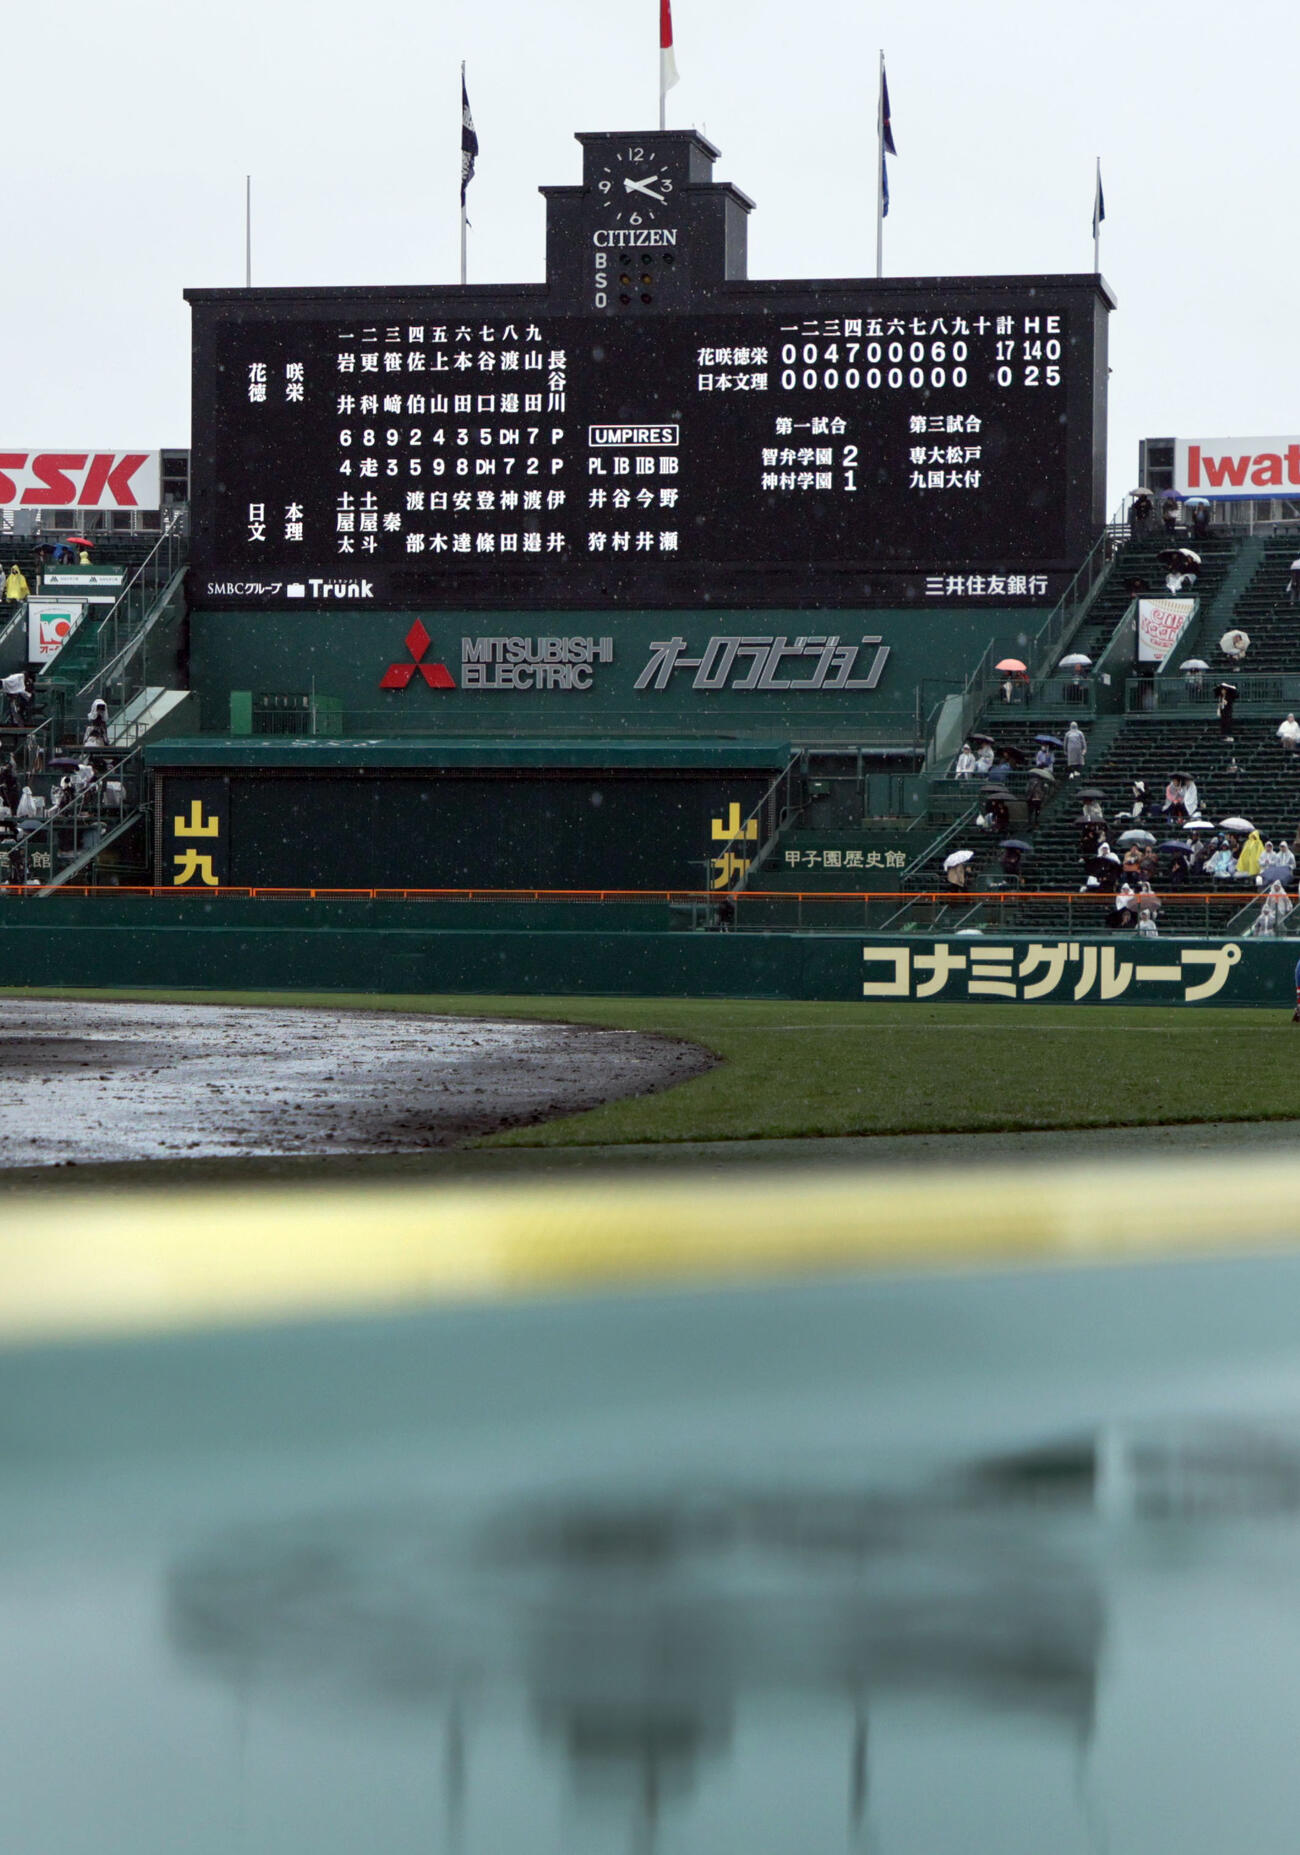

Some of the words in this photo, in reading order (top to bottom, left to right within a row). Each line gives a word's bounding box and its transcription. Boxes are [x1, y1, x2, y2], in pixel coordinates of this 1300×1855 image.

[630, 148, 643, 161] 12
[599, 181, 611, 193] 9
[661, 180, 672, 192] 3
[630, 212, 642, 225] 6
[593, 229, 677, 247] CITIZEN
[596, 253, 606, 268] B
[596, 273, 607, 288] S
[698, 347, 768, 366] 花咲徳栄
[699, 373, 768, 391] 日本文理
[776, 417, 846, 435] 第一試合
[910, 415, 981, 433] 第三試合
[596, 429, 674, 444] UMPIRES
[762, 448, 832, 466] 智弁学園
[843, 445, 858, 466] 2
[910, 446, 981, 464] 専大松戸
[761, 472, 832, 490] 神村学園
[844, 470, 856, 490] 1
[910, 470, 981, 488] 九国大付
[208, 583, 282, 594] SMBCグループ
[926, 575, 1048, 595] 三井住友銀行
[461, 637, 613, 662] MITSUBISHI
[634, 636, 891, 689] オーロラビジョン
[461, 663, 593, 690] ELECTRIC
[863, 943, 1241, 1002] コナミグループ
